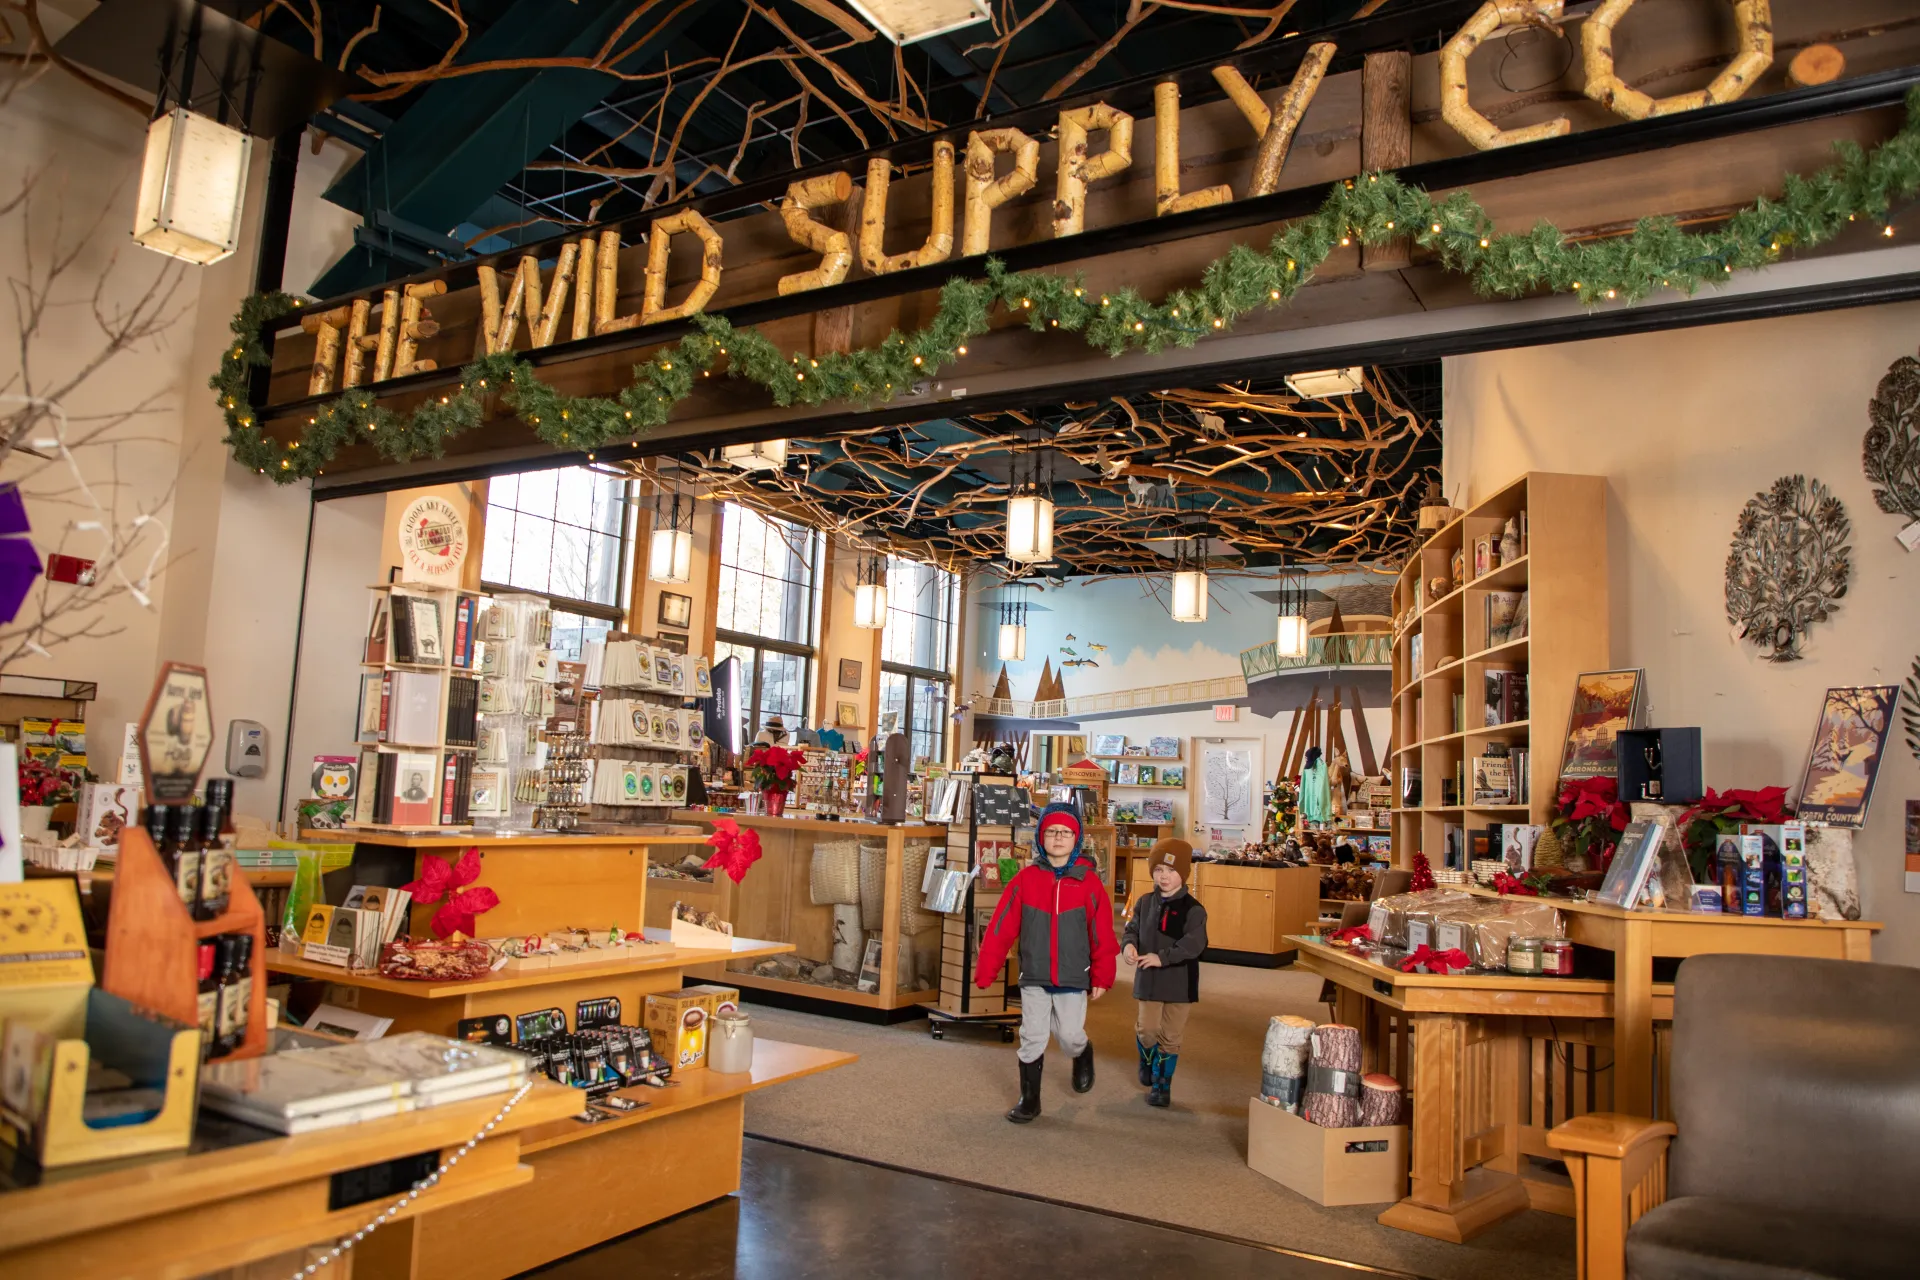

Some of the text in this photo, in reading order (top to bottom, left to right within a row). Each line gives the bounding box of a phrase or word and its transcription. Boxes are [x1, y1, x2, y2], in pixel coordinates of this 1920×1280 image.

[301, 278, 448, 396] THE
[476, 205, 724, 354] WILD
[777, 41, 1337, 297] SUPPLY
[1564, 765, 1618, 773] ADIRONDACKS
[1825, 812, 1863, 823] COUNTRY
